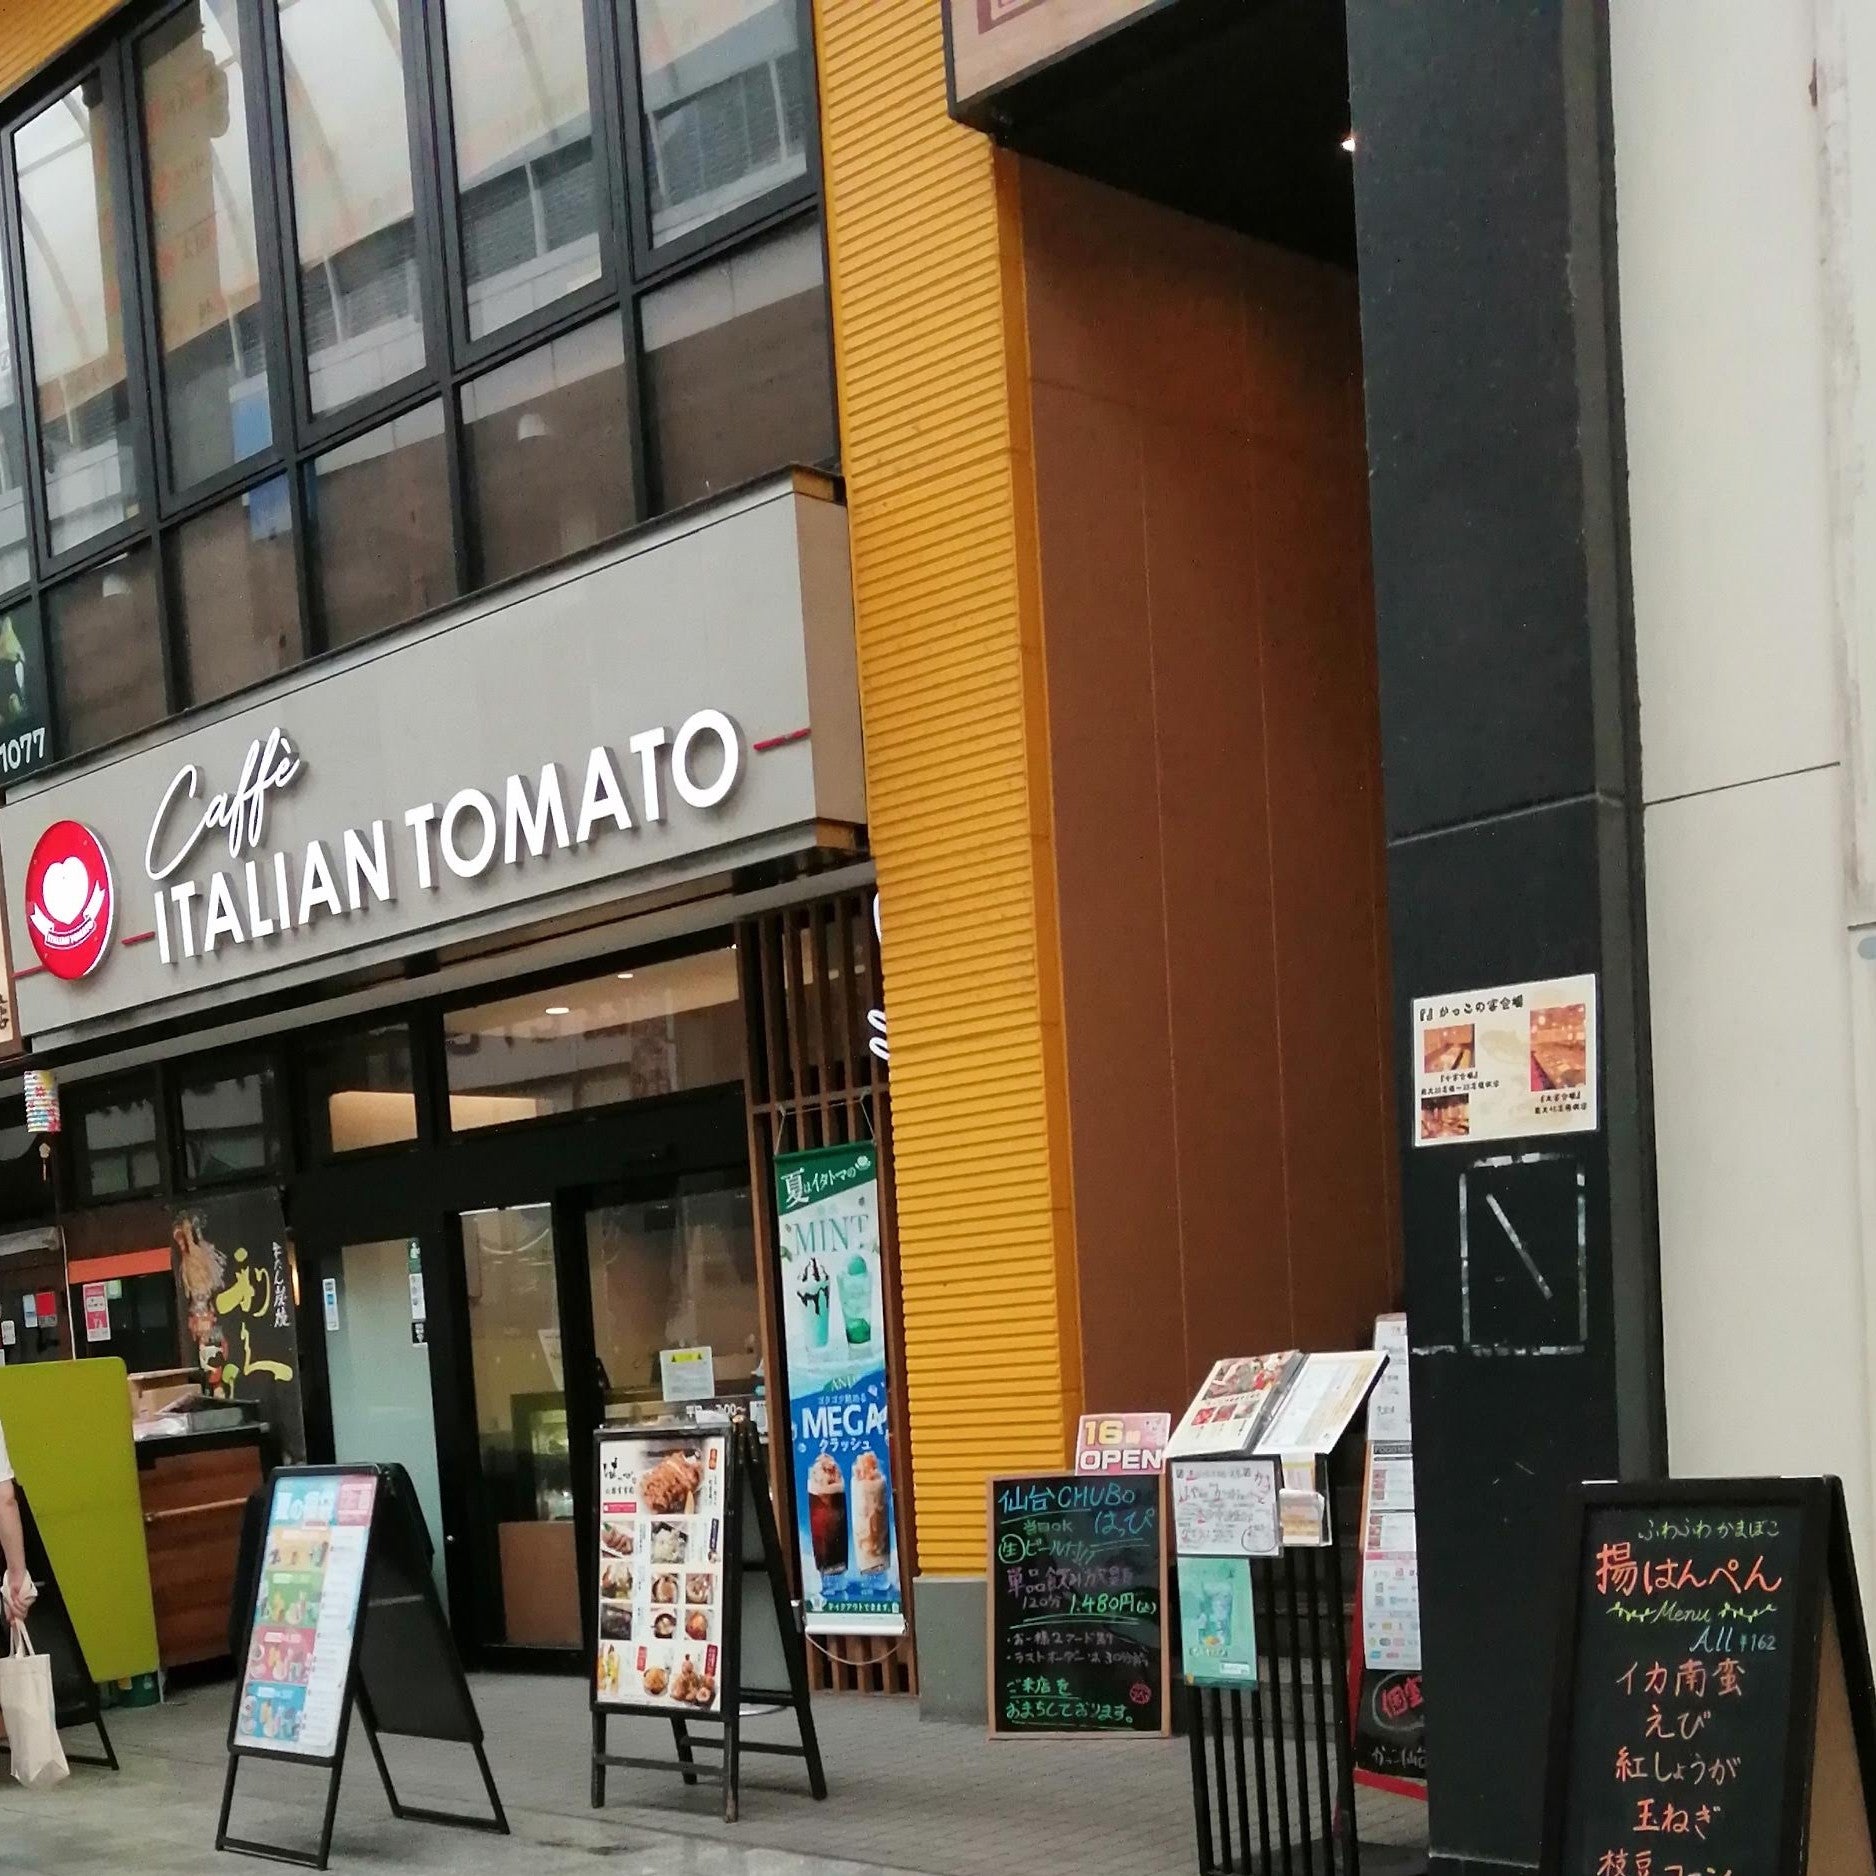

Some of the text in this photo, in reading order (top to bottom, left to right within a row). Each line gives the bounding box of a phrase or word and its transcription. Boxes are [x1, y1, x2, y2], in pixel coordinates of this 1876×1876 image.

[145, 726, 300, 881] Caffè
[154, 708, 740, 964] ITALIAN TOMATO
[794, 1214, 869, 1255] MINT
[801, 1402, 884, 1440] MEGA
[819, 1437, 871, 1453] クラッシュ
[1080, 1449, 1162, 1470] OPEN
[1596, 1541, 1783, 1597] 揚はんぺん
[1650, 1599, 1711, 1624] Menu
[1689, 1626, 1734, 1653] All
[1615, 1657, 1746, 1698] イカ南蛮
[1645, 1704, 1711, 1740] えび
[1615, 1746, 1742, 1785] 紅しょうが
[1633, 1798, 1721, 1840] 玉ねぎ
